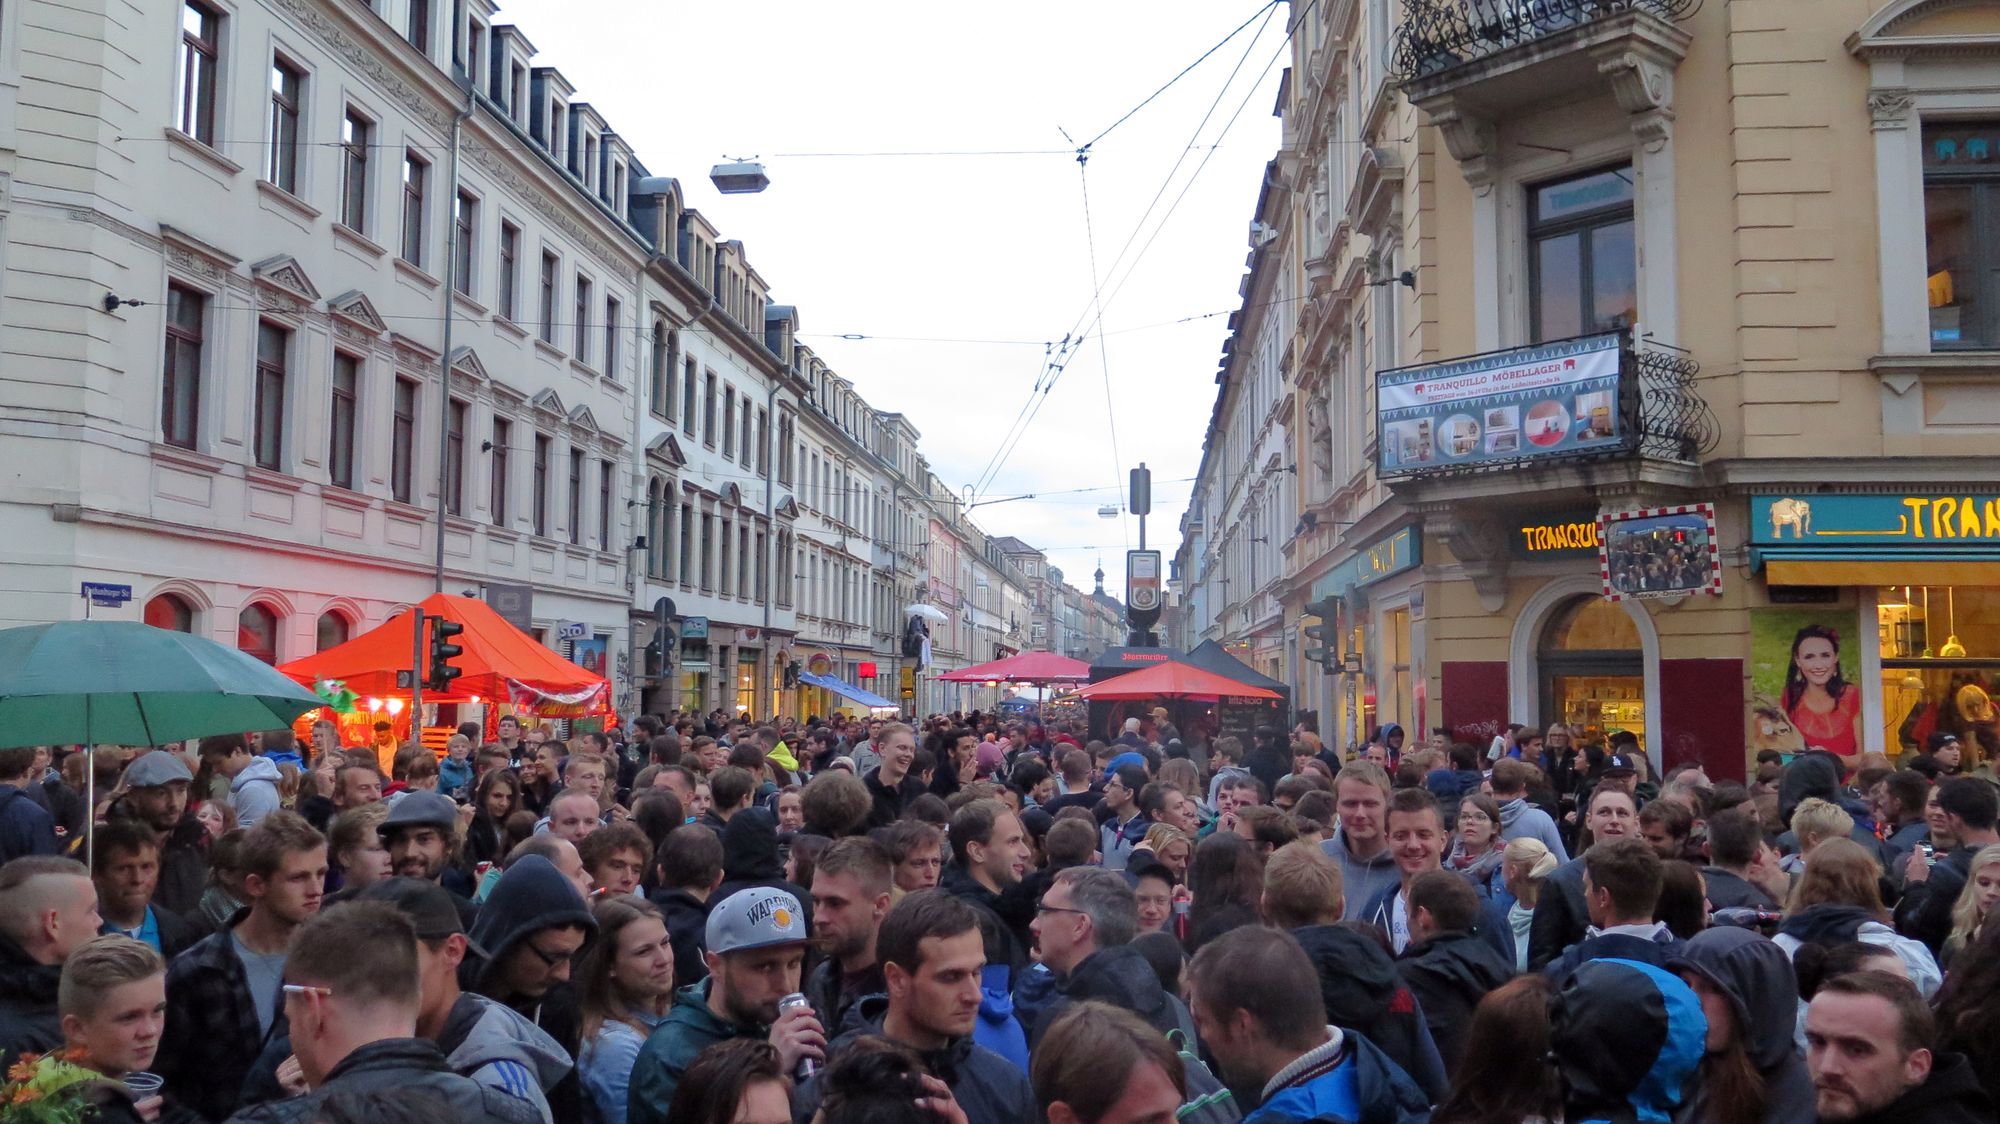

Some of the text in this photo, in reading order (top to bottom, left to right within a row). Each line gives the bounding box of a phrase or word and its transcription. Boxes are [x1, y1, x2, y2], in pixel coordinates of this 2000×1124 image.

[1427, 364, 1561, 392] TRANQUILLO MÖBELLAGER
[559, 624, 582, 637] sto
[1121, 652, 1169, 661] Jägermeister
[1612, 755, 1621, 766] LA
